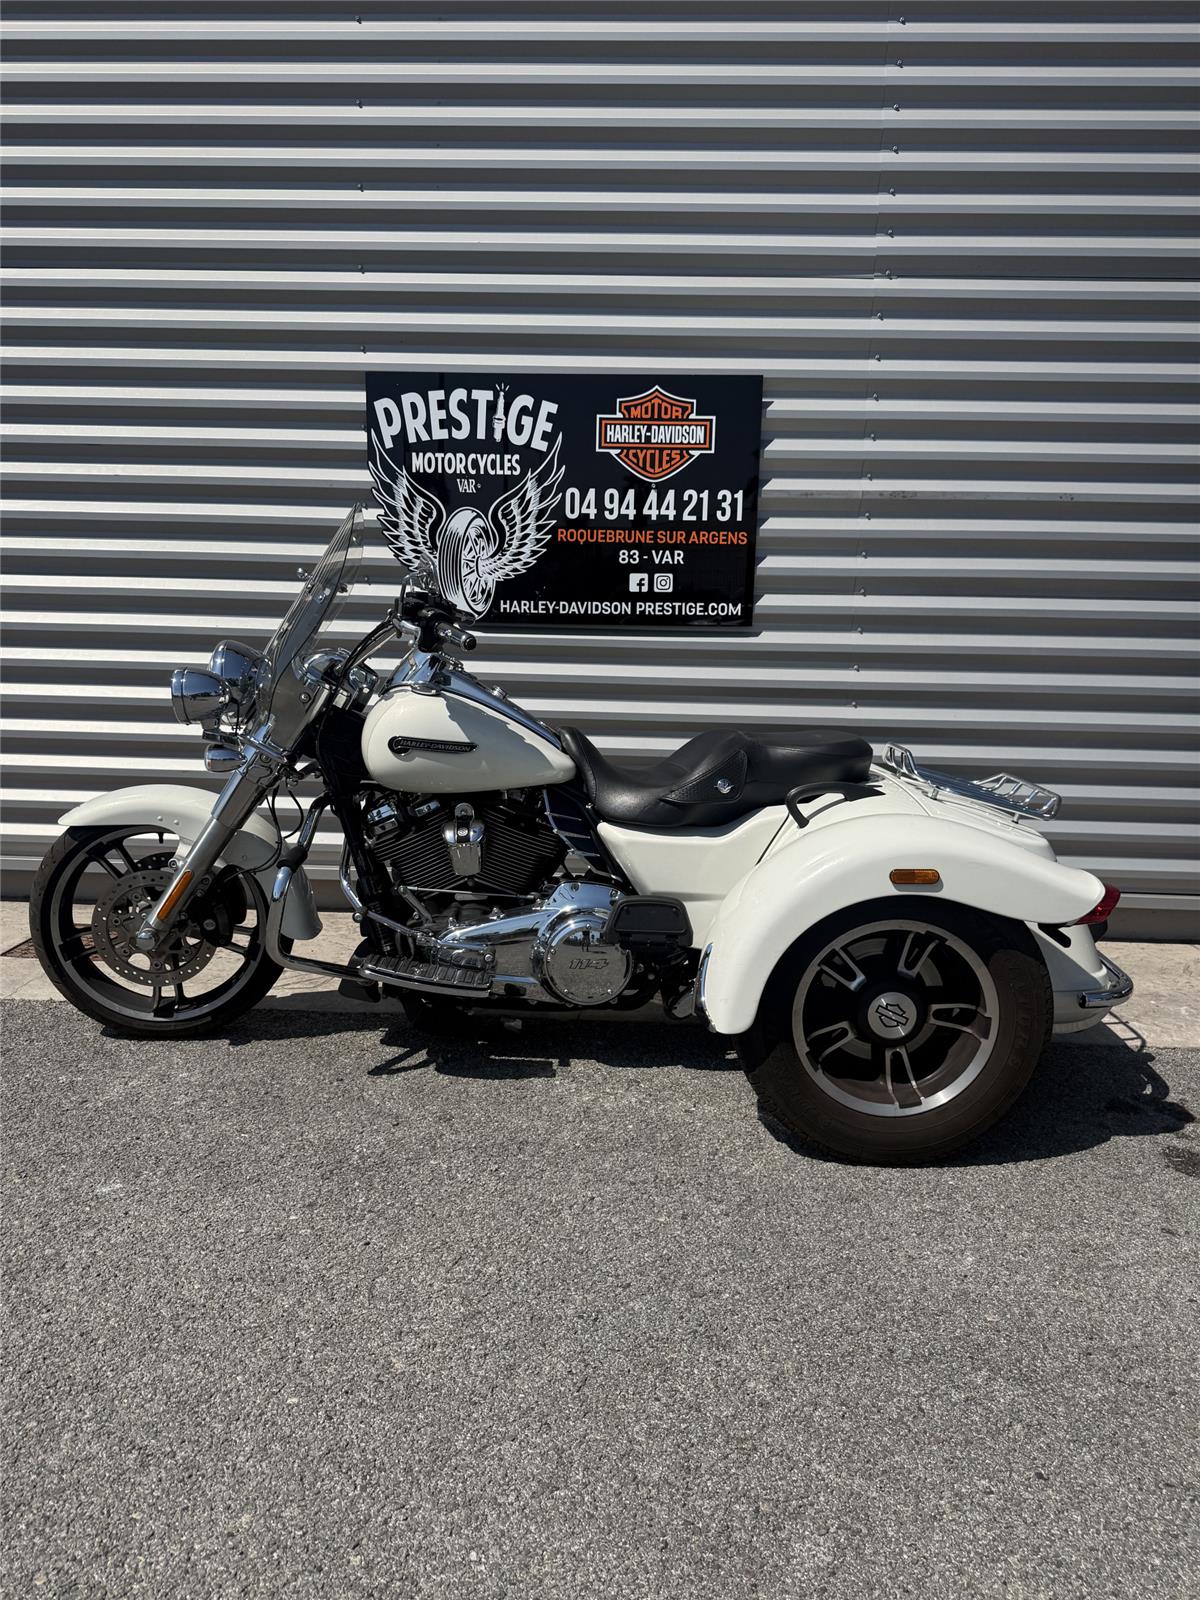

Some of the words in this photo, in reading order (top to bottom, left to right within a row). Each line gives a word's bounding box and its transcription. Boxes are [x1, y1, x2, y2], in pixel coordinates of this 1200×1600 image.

[630, 398, 682, 419] MOTOR
[373, 387, 559, 452] PRESTIGE
[606, 424, 705, 444] HARLEY-DAVIDSON
[411, 452, 521, 475] MOTORCYCLES
[628, 449, 681, 473] CYCLES
[457, 478, 477, 493] VAR
[565, 487, 597, 520] 04
[604, 488, 636, 521] 94
[642, 488, 676, 521] 44
[683, 489, 709, 521] 21
[716, 489, 744, 522] 31
[557, 528, 654, 544] ROQUEBRUNE
[657, 530, 686, 544] SUR
[688, 531, 748, 545] ARGENS
[618, 550, 640, 564] 83
[652, 551, 684, 565] VAR
[500, 600, 631, 615] HARLEY-DAVIDSON
[636, 602, 742, 616] PRESTIGE.COM
[400, 740, 471, 752] HARLEY-DAVIDSON
[569, 958, 609, 970] 114
